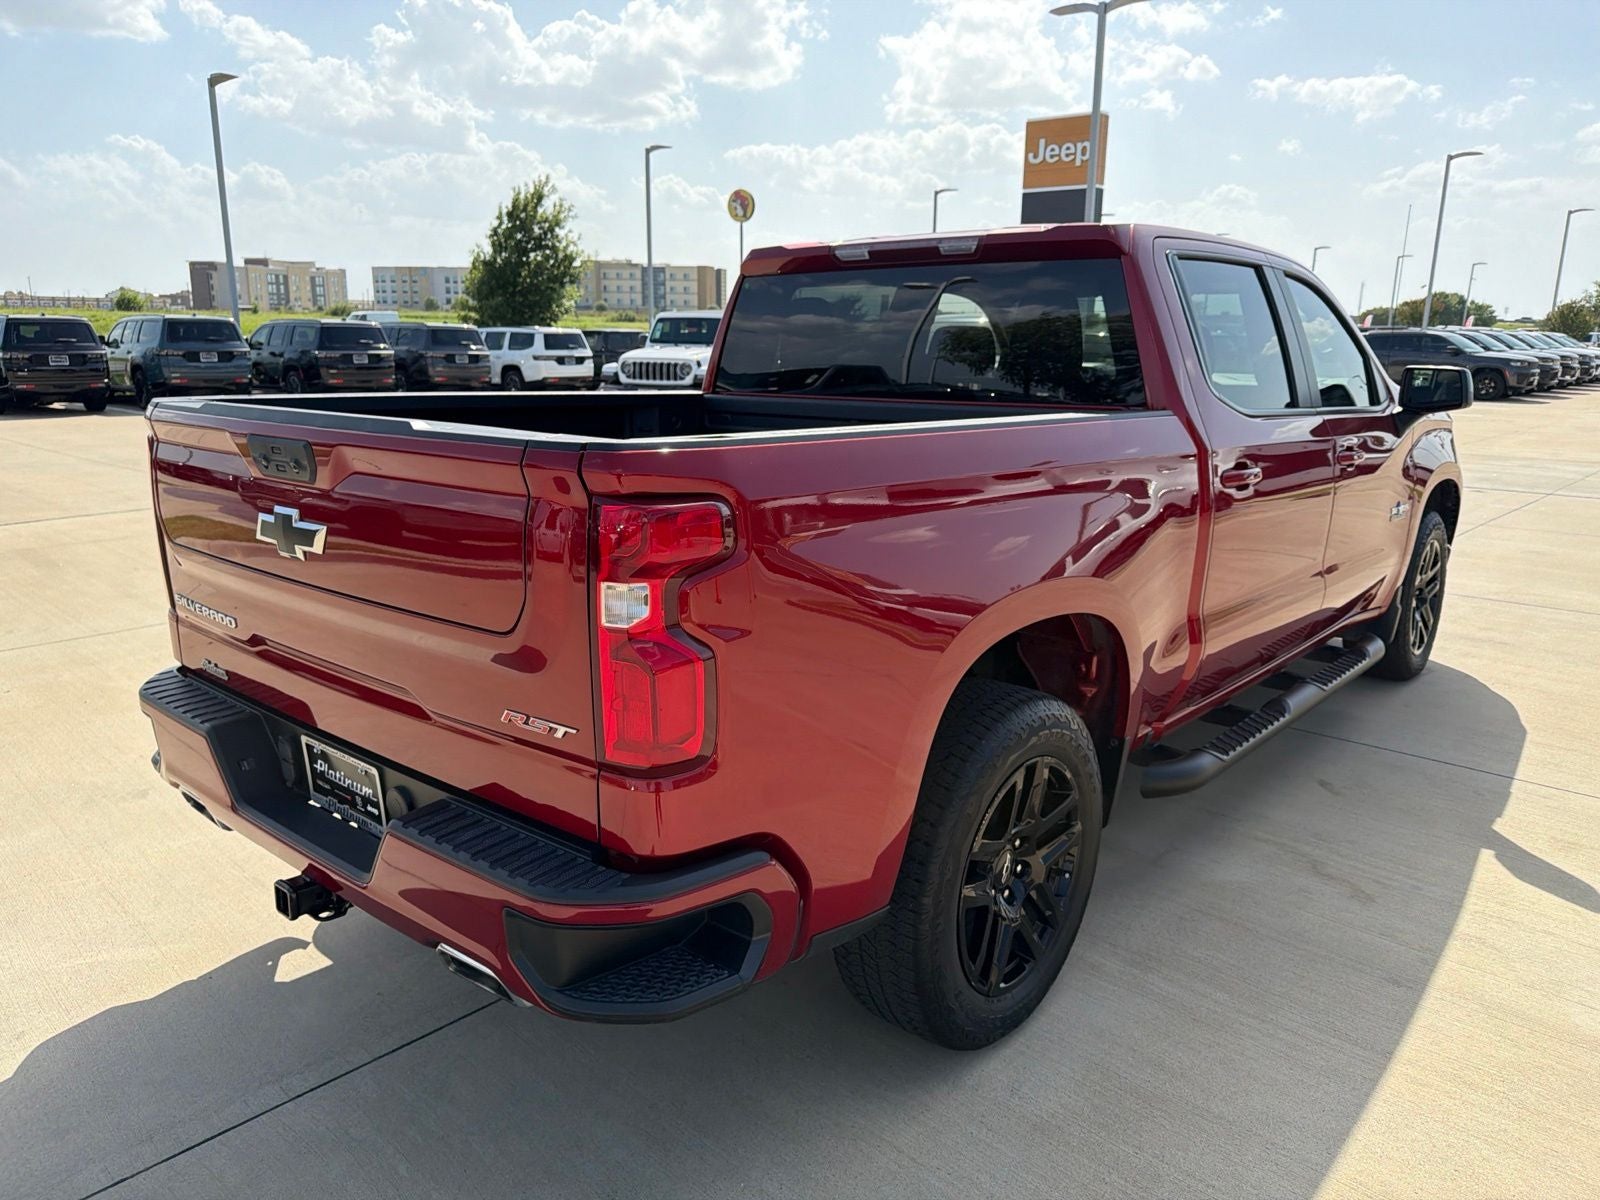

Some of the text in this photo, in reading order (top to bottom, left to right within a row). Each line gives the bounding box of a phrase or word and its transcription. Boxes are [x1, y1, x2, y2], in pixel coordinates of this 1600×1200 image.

[1028, 138, 1090, 166] Jeep
[174, 593, 236, 629] SILVERADO
[500, 709, 579, 739] RST
[314, 760, 378, 801] Platinum
